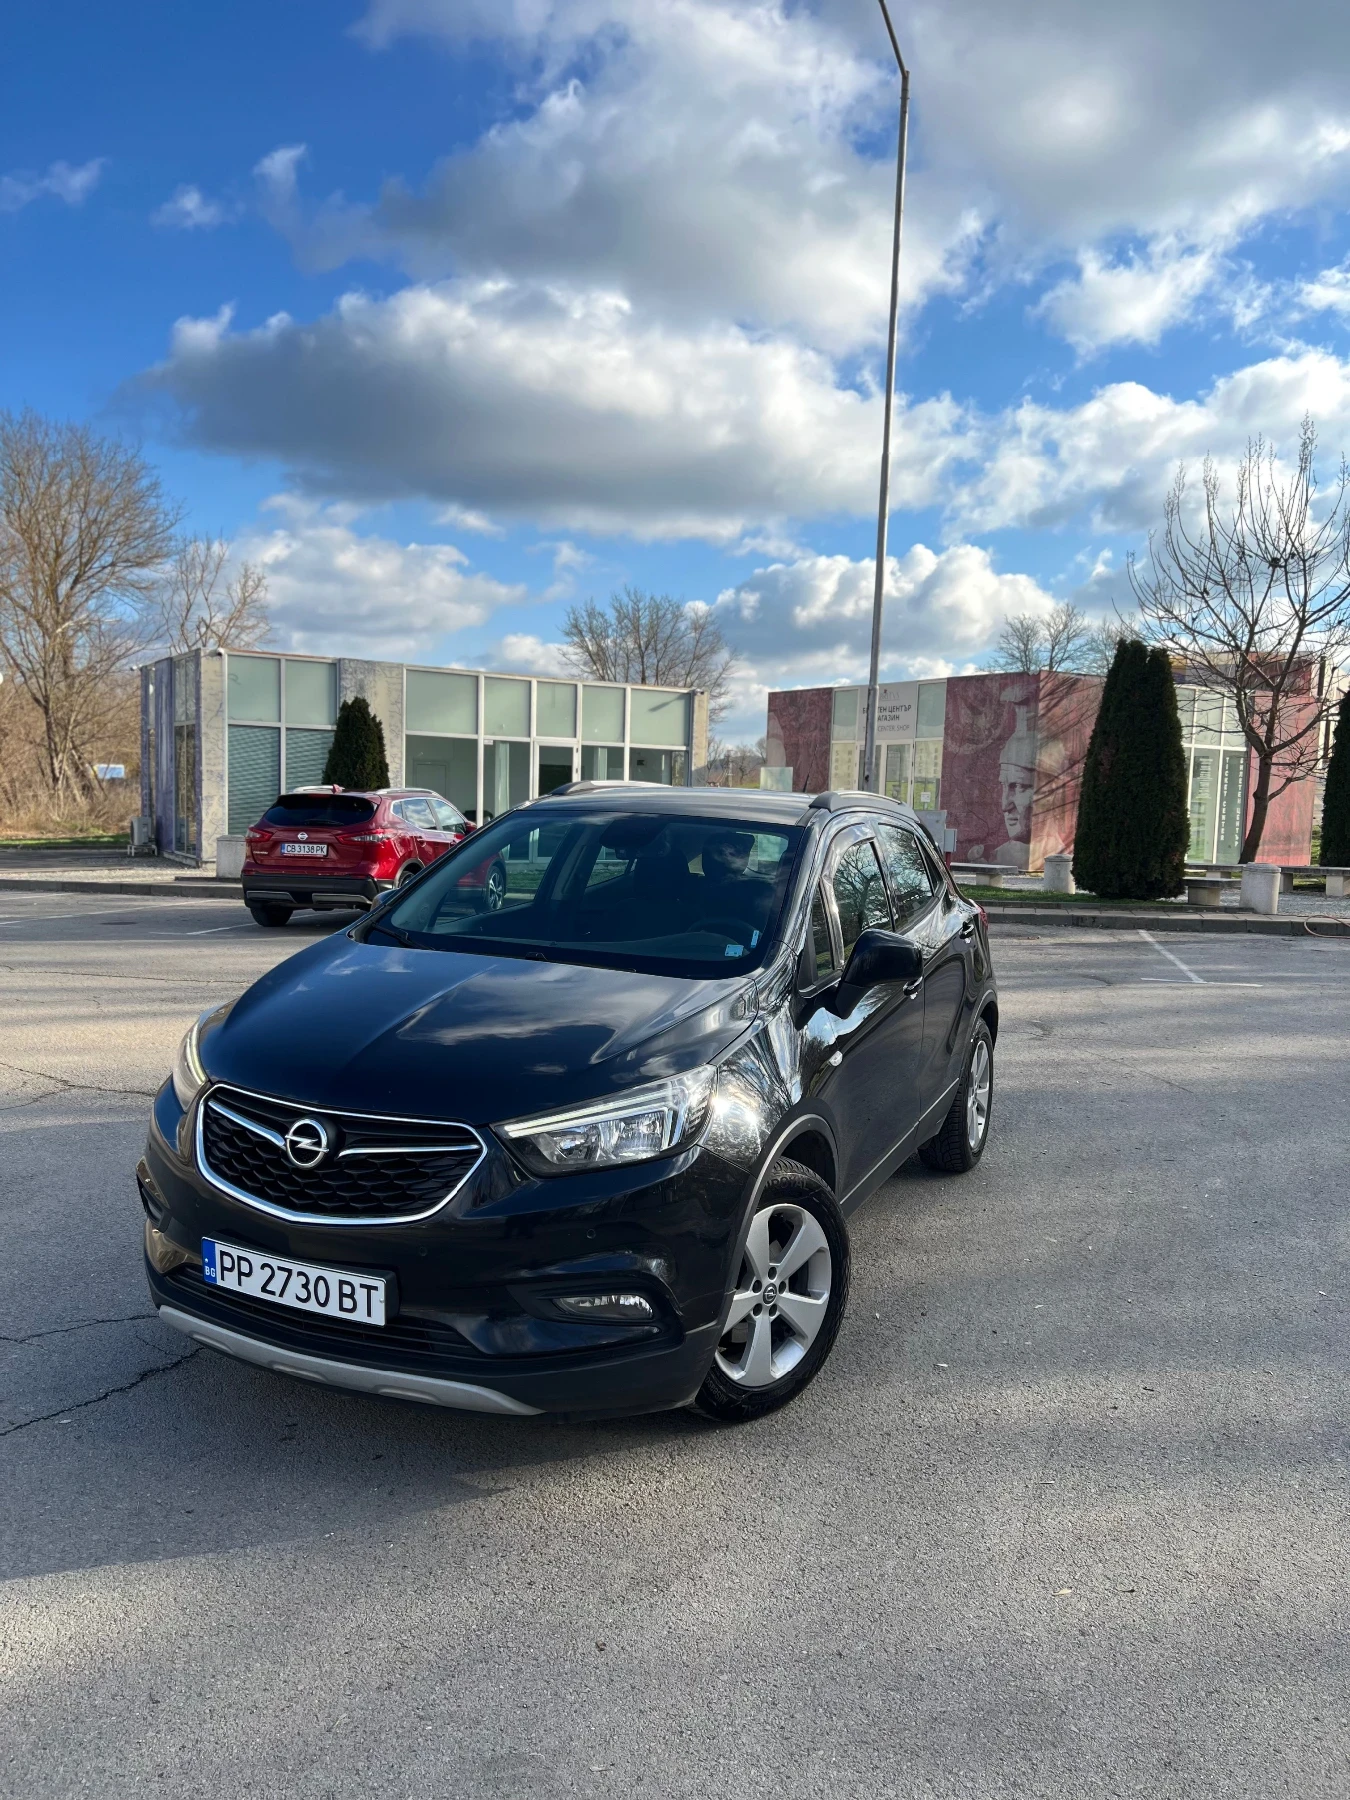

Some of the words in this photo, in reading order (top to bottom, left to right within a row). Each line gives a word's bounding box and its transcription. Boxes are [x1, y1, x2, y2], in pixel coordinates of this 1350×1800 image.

[862, 705, 887, 715] БТЕН
[888, 704, 912, 713] ЦЕНТЪР
[877, 714, 900, 722] АГАЗИН
[286, 844, 296, 853] CB
[297, 845, 315, 853] 3138
[316, 845, 326, 854] PK
[204, 1265, 216, 1278] BG
[219, 1249, 253, 1287] PP
[260, 1262, 330, 1308] 2730
[338, 1278, 379, 1318] BT
[705, 1377, 728, 1405] AllSeaso
